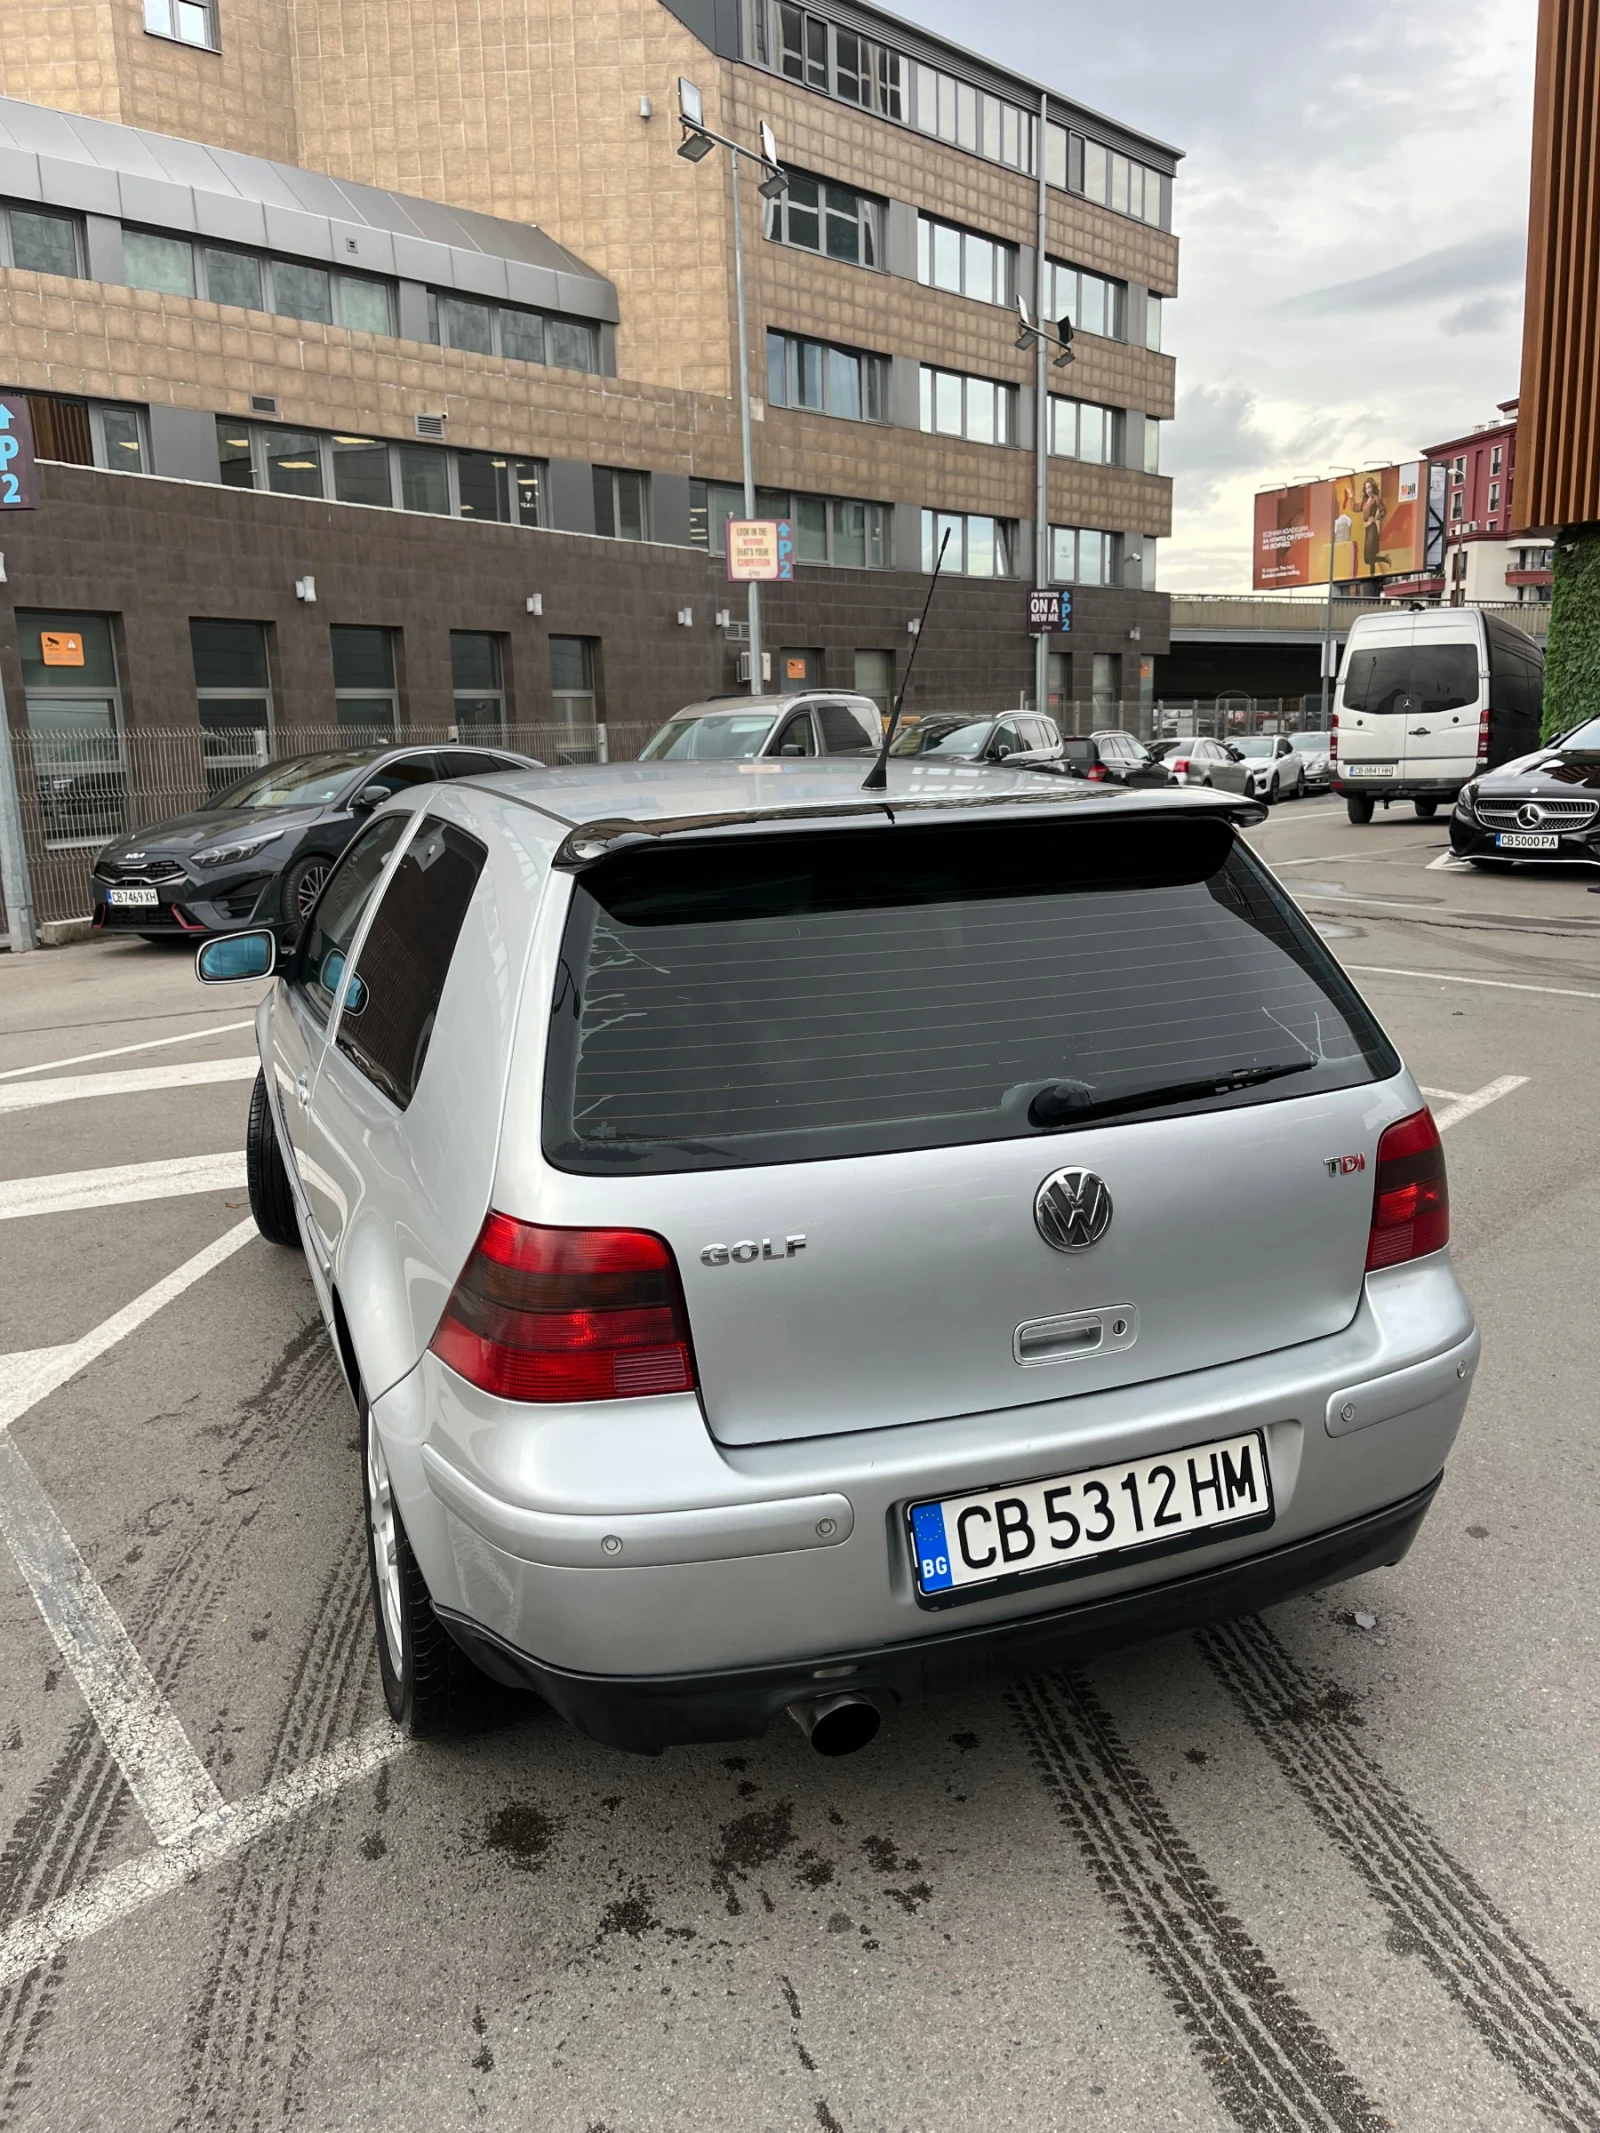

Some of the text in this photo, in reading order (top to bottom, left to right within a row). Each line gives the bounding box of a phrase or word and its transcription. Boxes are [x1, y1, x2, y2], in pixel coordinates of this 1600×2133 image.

[736, 528, 768, 536] LOOK IN THE
[736, 548, 769, 557] THAT'S YOUR
[1030, 598, 1059, 613] ON A
[1031, 613, 1059, 622] NEW ME
[1323, 1152, 1366, 1178] TDI
[700, 1234, 806, 1267] GOLF
[922, 1556, 948, 1580] BG
